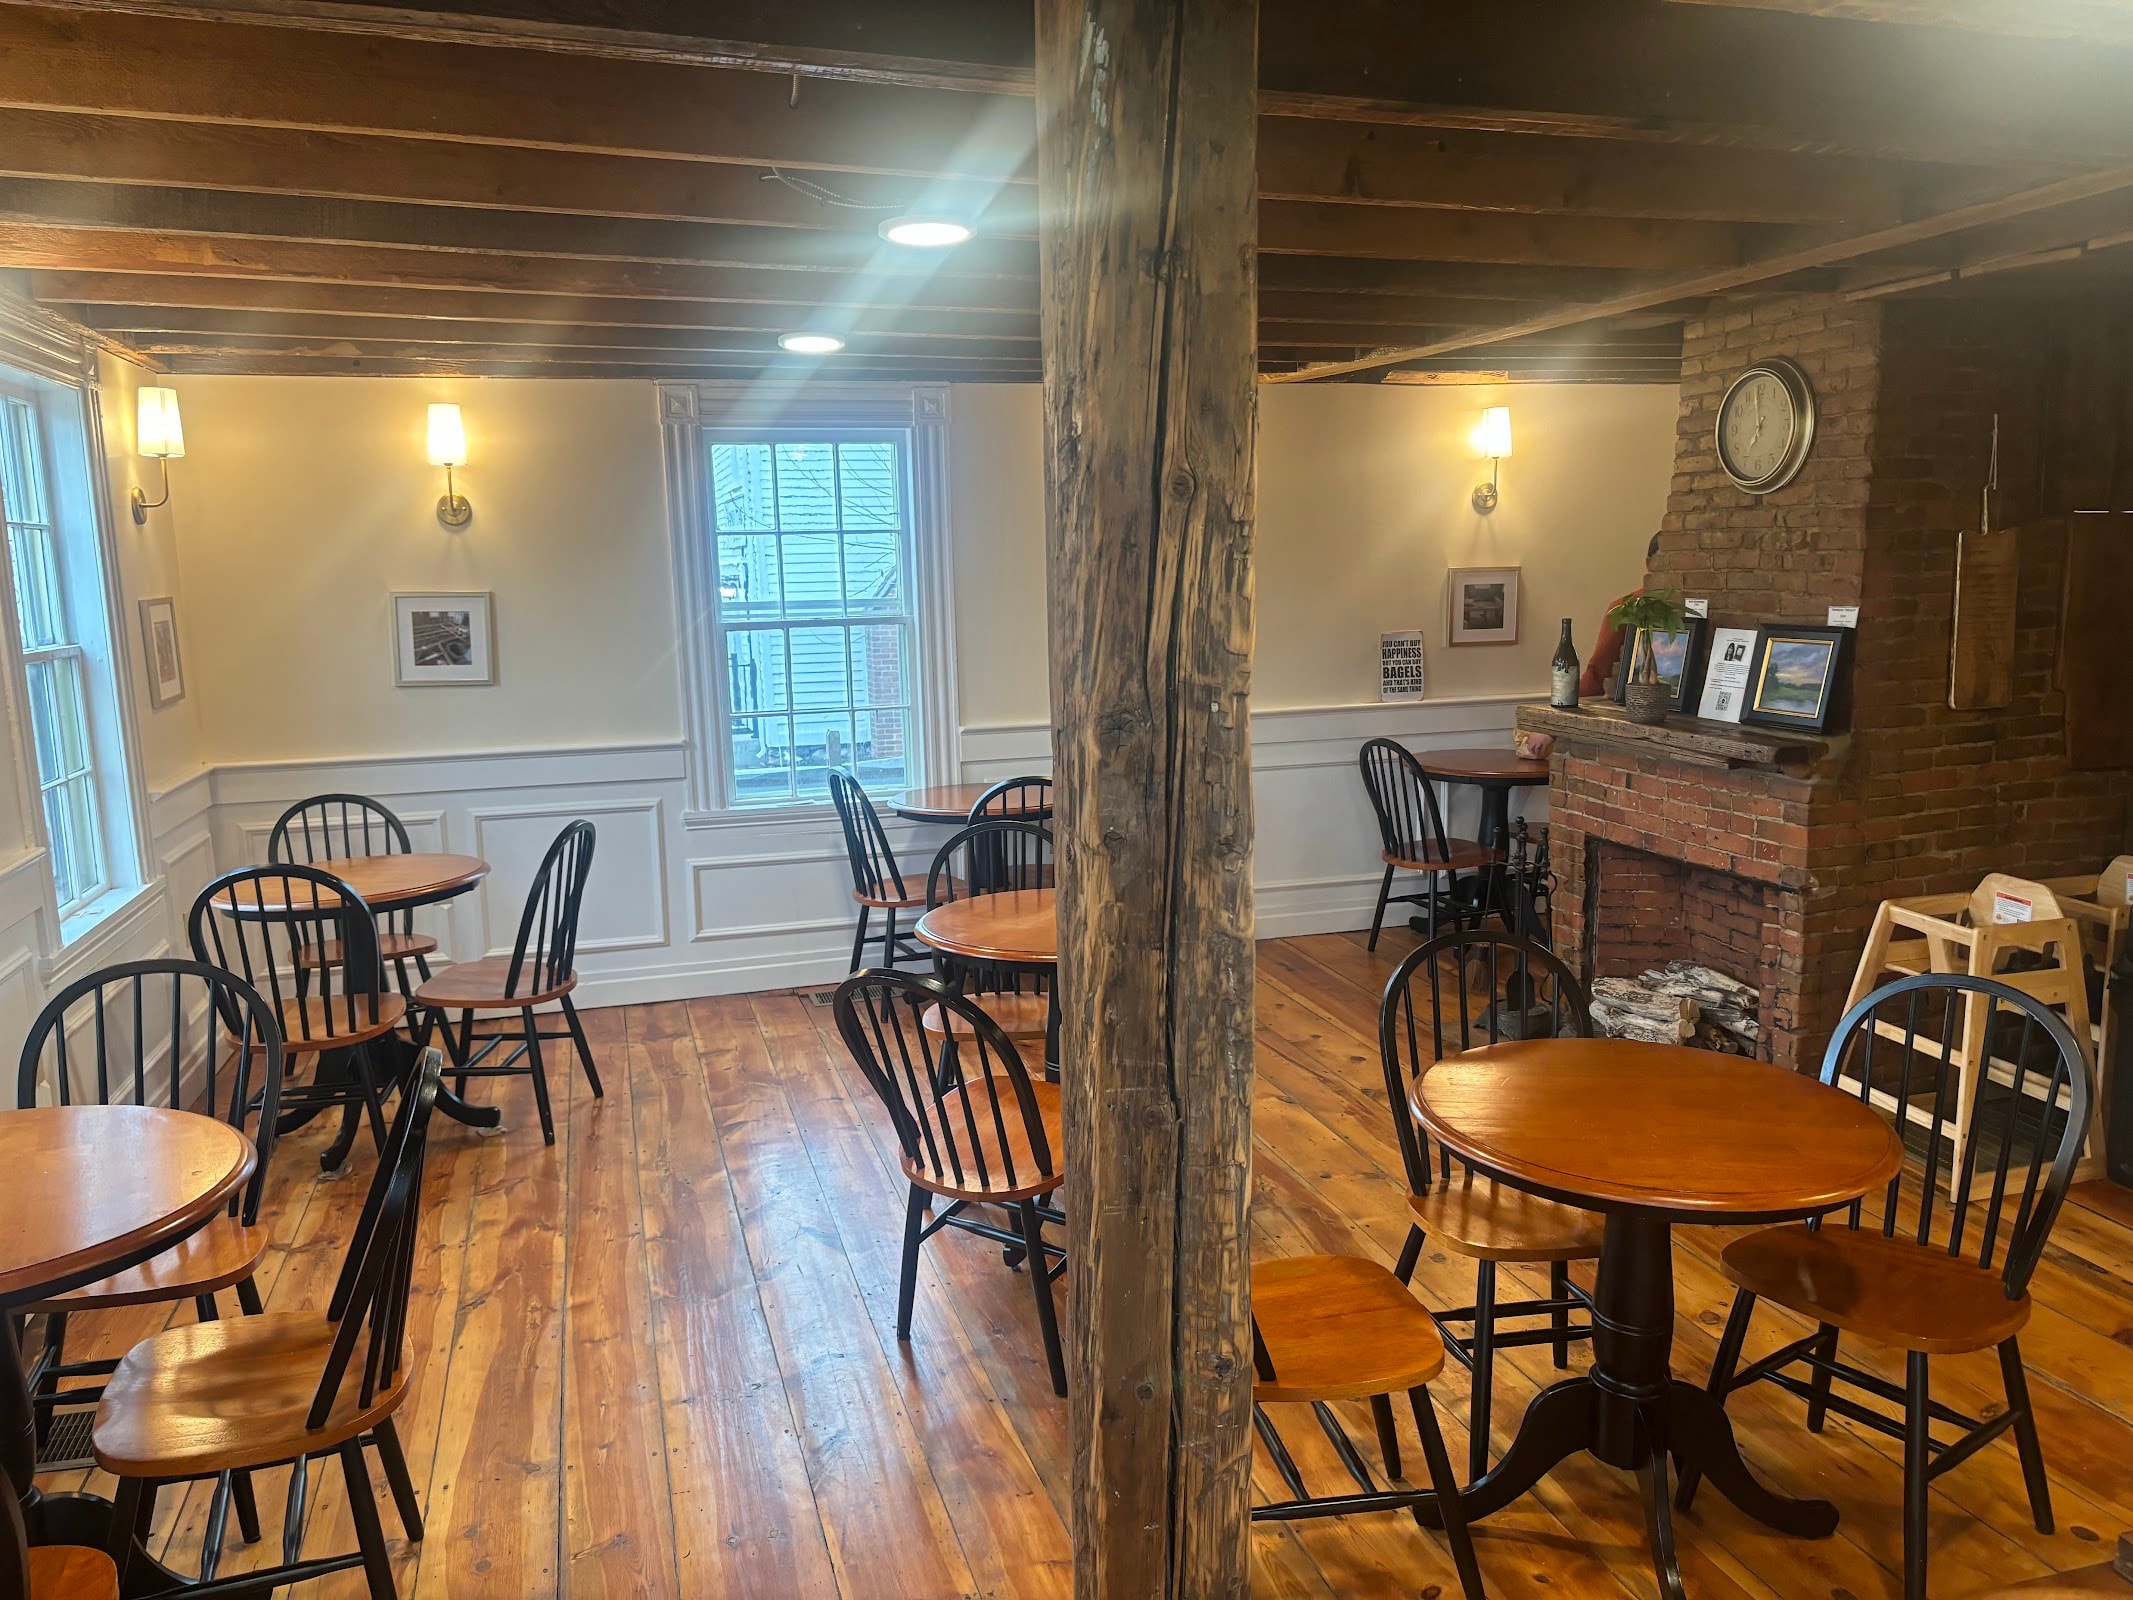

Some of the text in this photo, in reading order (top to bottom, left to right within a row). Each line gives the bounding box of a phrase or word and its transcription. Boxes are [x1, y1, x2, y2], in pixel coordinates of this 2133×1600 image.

[1735, 406, 1743, 418] 10
[1731, 425, 1738, 437] 9
[1755, 460, 1761, 471] 6
[1382, 648, 1422, 659] HAPPINESS
[1382, 666, 1422, 679] BAGELS
